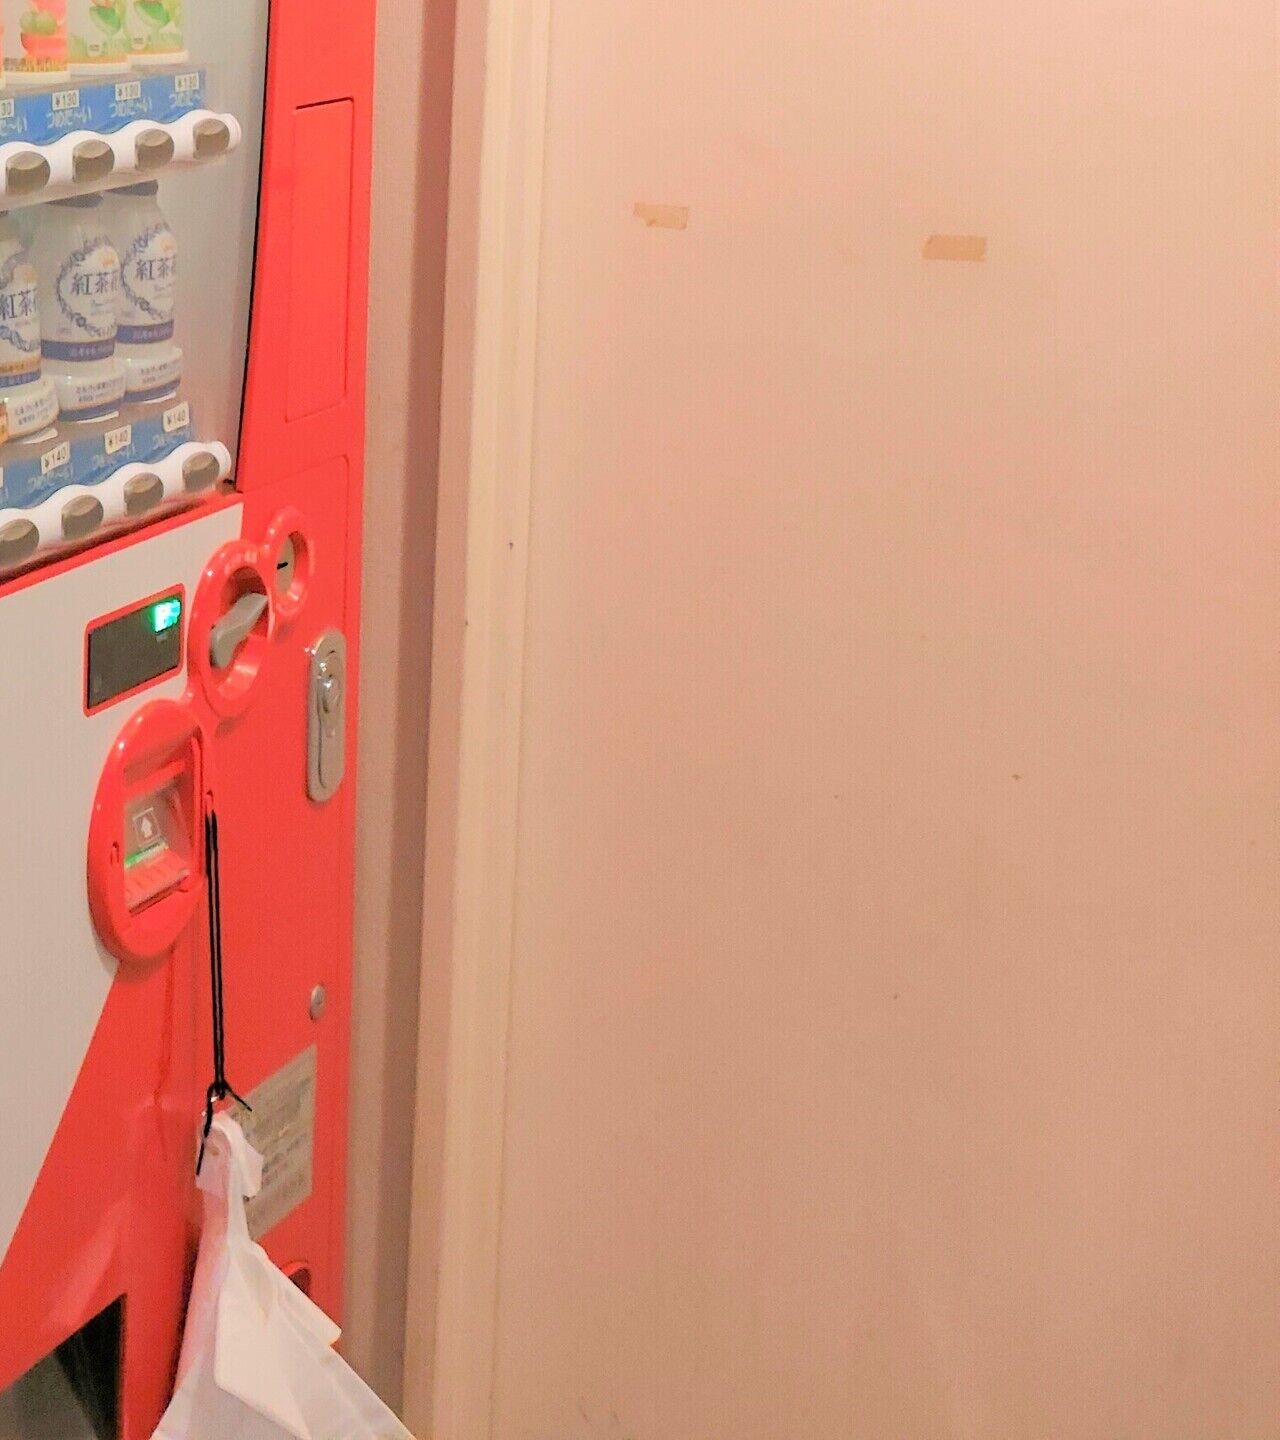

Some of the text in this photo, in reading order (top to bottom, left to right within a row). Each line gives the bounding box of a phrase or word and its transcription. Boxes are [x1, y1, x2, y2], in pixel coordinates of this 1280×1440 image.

[135, 256, 176, 281] 紅茶
[166, 409, 186, 427] ¥140
[44, 446, 67, 469] ¥140
